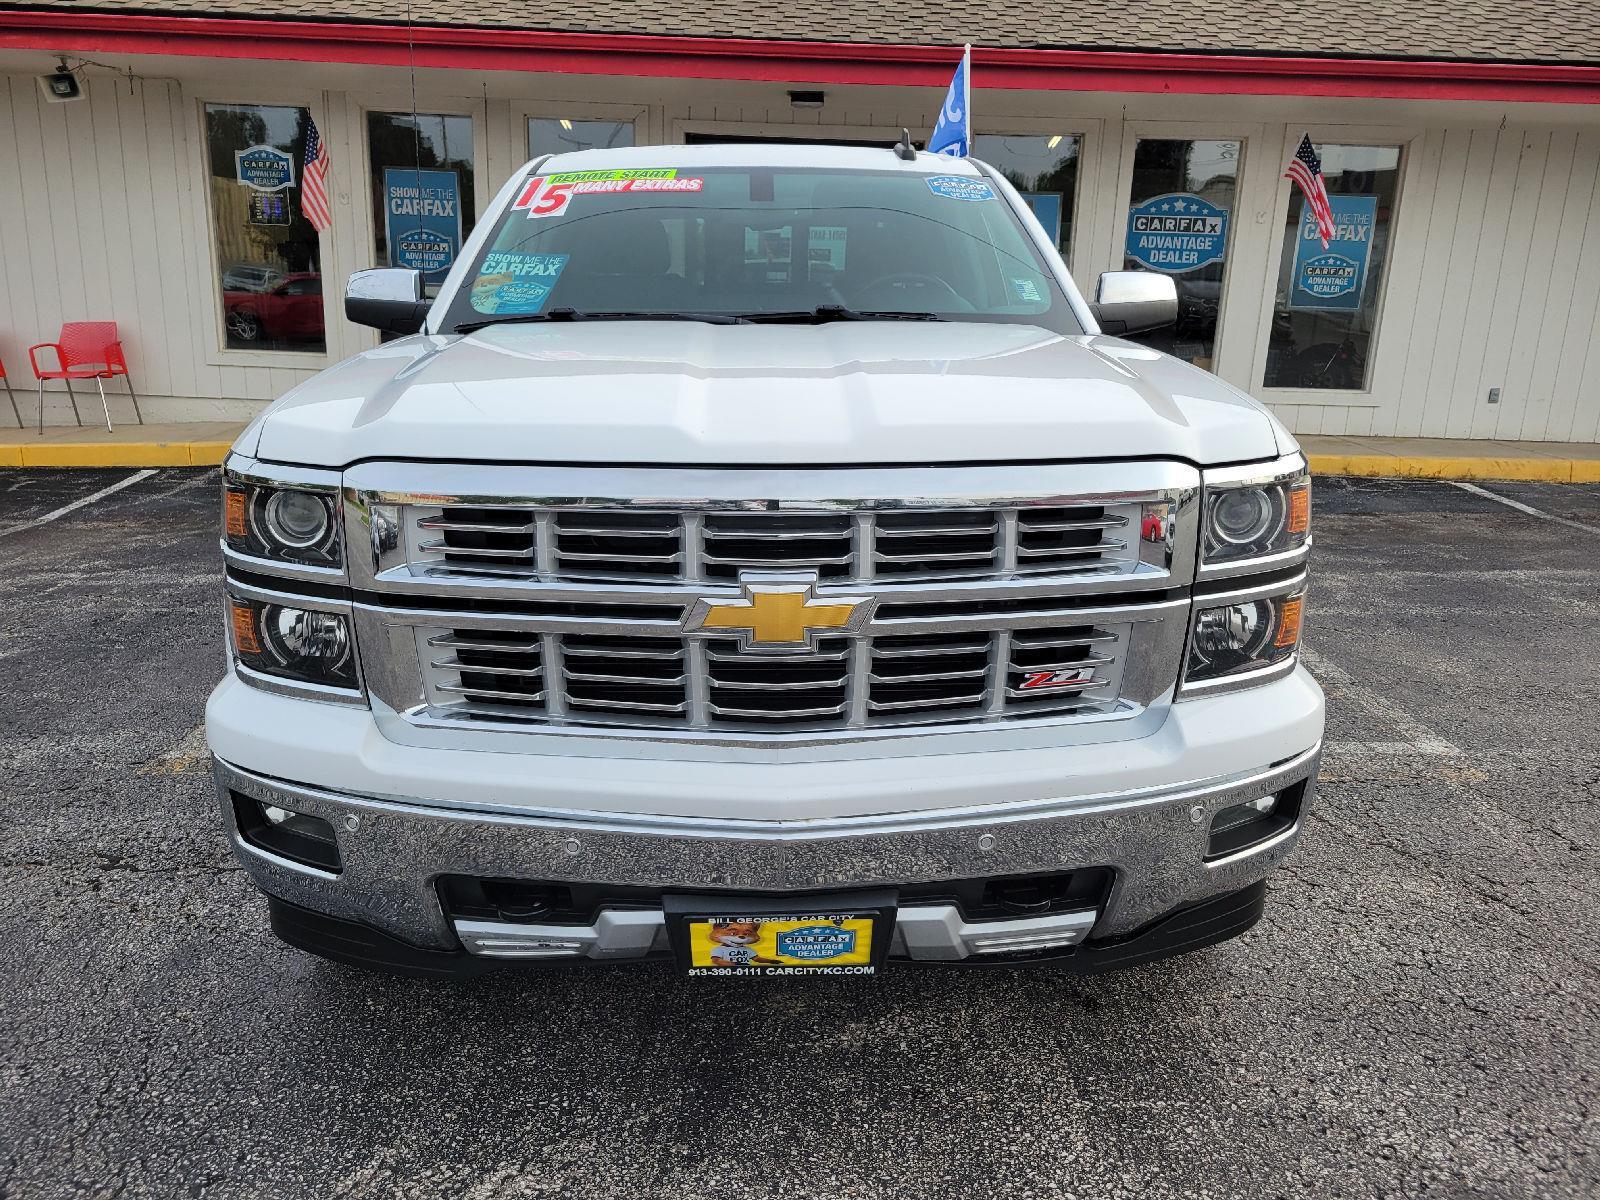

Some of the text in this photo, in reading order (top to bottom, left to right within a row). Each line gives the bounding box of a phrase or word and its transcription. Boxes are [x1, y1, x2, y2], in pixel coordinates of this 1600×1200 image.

[244, 161, 288, 170] CARFAX
[552, 170, 671, 183] REMOTE START
[573, 179, 703, 193] MANY EXTRAS
[390, 187, 454, 200] SHOW ME THE
[516, 177, 574, 215] 15
[391, 198, 455, 216] CARFAX
[1338, 213, 1351, 224] ME
[1352, 213, 1370, 225] THE
[1135, 217, 1219, 234] CARFAX
[402, 242, 448, 252] CARFAX
[1139, 235, 1213, 250] ADVANTAGE
[405, 252, 446, 260] ADVANTAGE
[485, 253, 562, 265] SHOW ME THE
[1149, 250, 1199, 263] DEALER
[412, 260, 439, 269] DEALER
[480, 261, 560, 276] CARFAX
[1307, 268, 1354, 276] CARFAX
[1308, 277, 1348, 285] ADVANTAGE
[1019, 668, 1096, 688] Z71
[784, 935, 849, 943] CARFAX
[688, 966, 875, 976] 913-390-0111 CARCITYKC.COM
